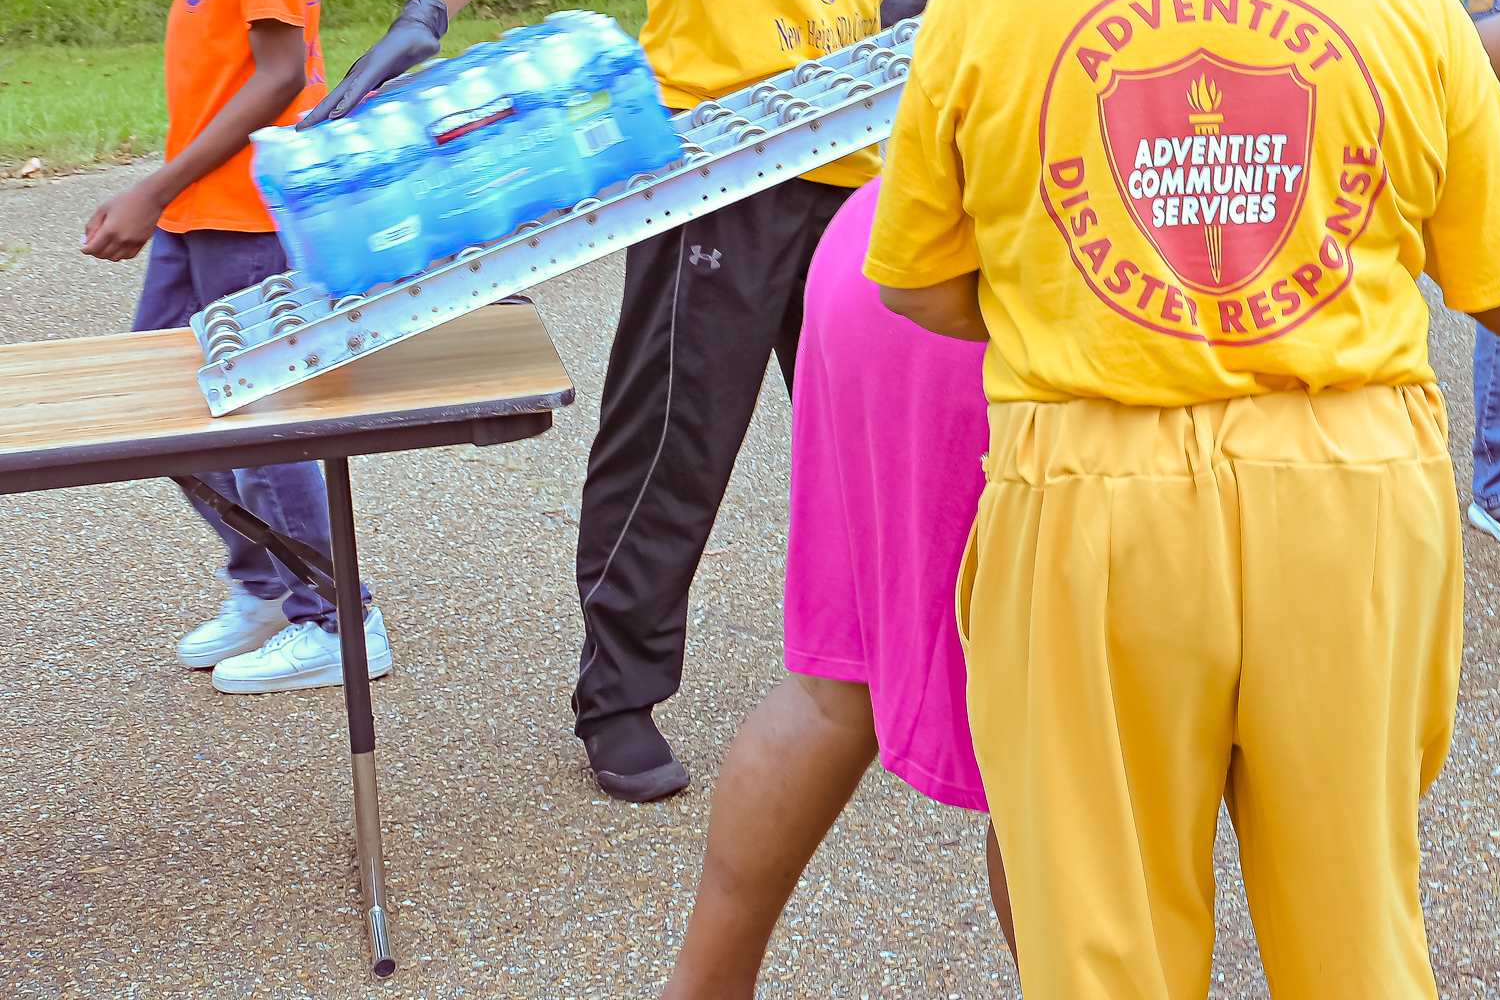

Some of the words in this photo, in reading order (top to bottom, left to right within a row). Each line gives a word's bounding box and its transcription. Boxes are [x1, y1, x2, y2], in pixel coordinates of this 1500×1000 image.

[775, 17, 802, 52] New
[1134, 134, 1288, 169] ADVENTIST
[1128, 163, 1303, 200] COMMUNITY
[1151, 193, 1277, 229] SERVICES
[1049, 156, 1199, 327] DISASTER
[1216, 145, 1378, 334] RESPONSE
